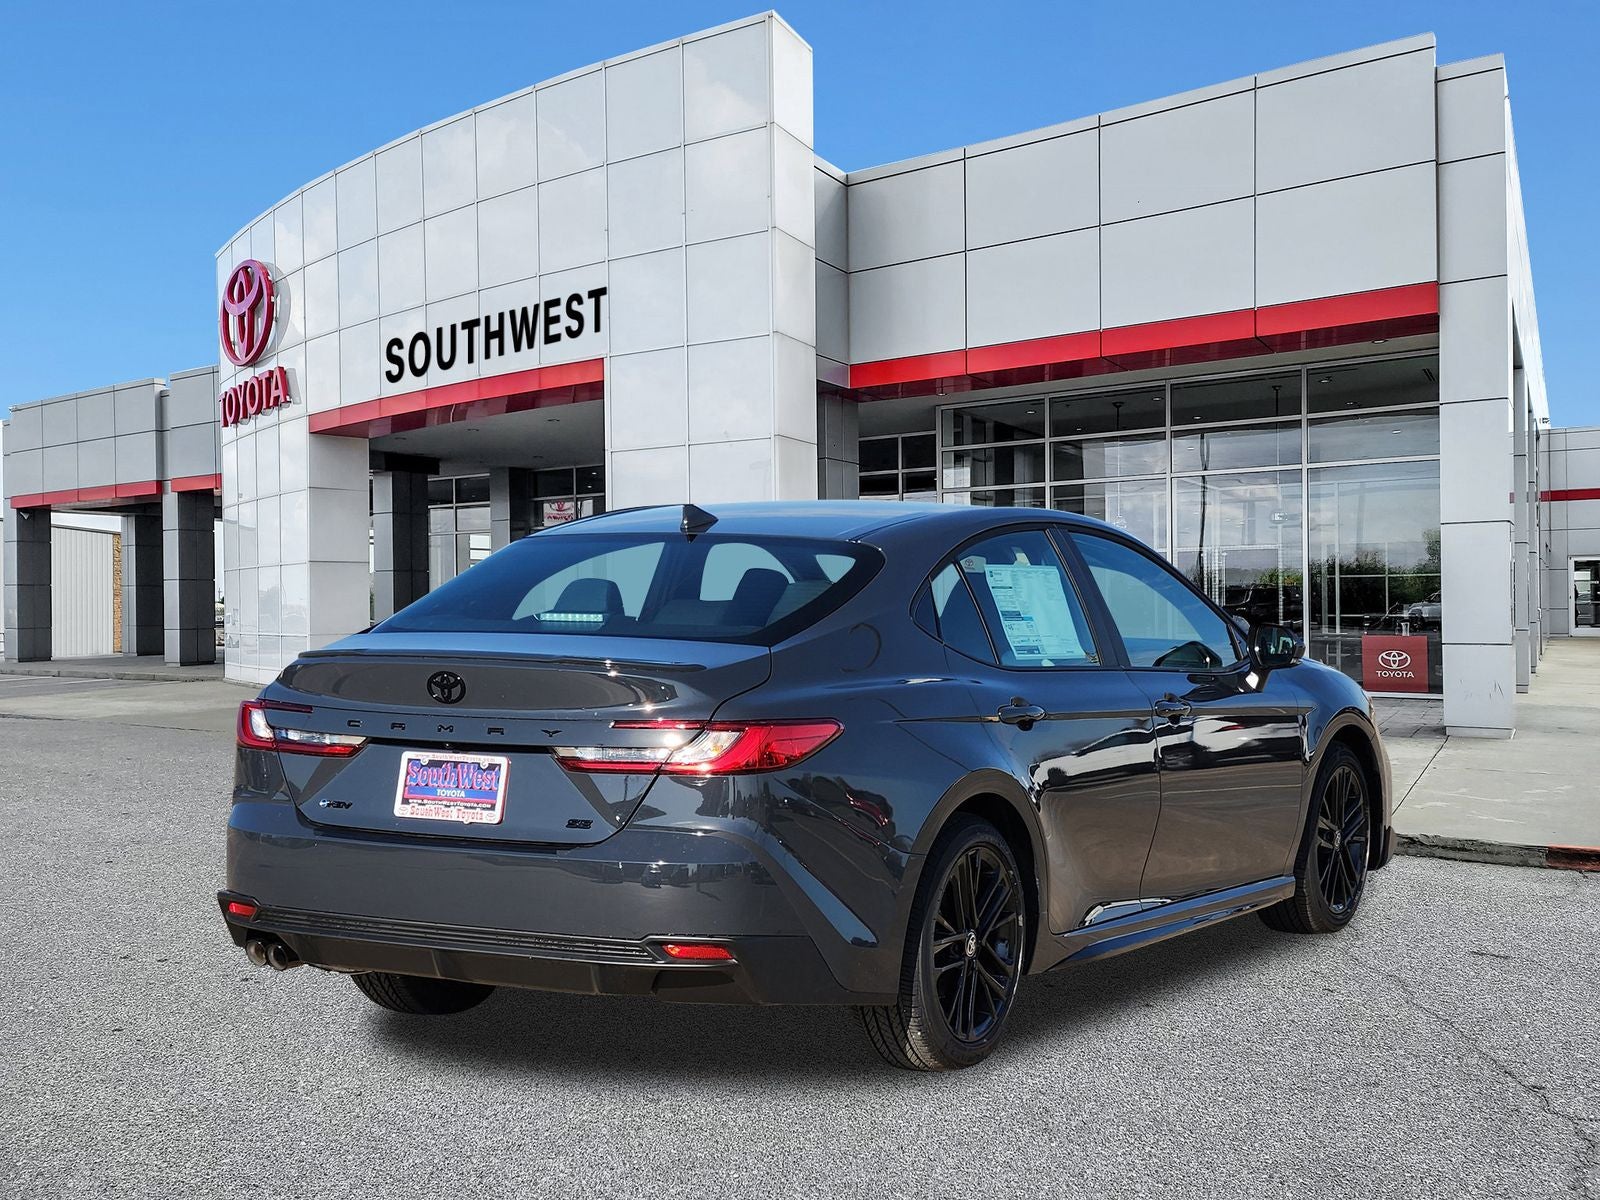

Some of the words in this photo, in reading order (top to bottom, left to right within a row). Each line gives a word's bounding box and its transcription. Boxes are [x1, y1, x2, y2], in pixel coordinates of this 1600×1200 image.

[385, 286, 607, 383] SOUTHWEST
[217, 366, 292, 428] TOYOTA
[1376, 670, 1415, 678] TOYOTA
[347, 719, 563, 737] CAMRY
[436, 788, 466, 798] TOYOTA
[456, 808, 484, 821] Toyota
